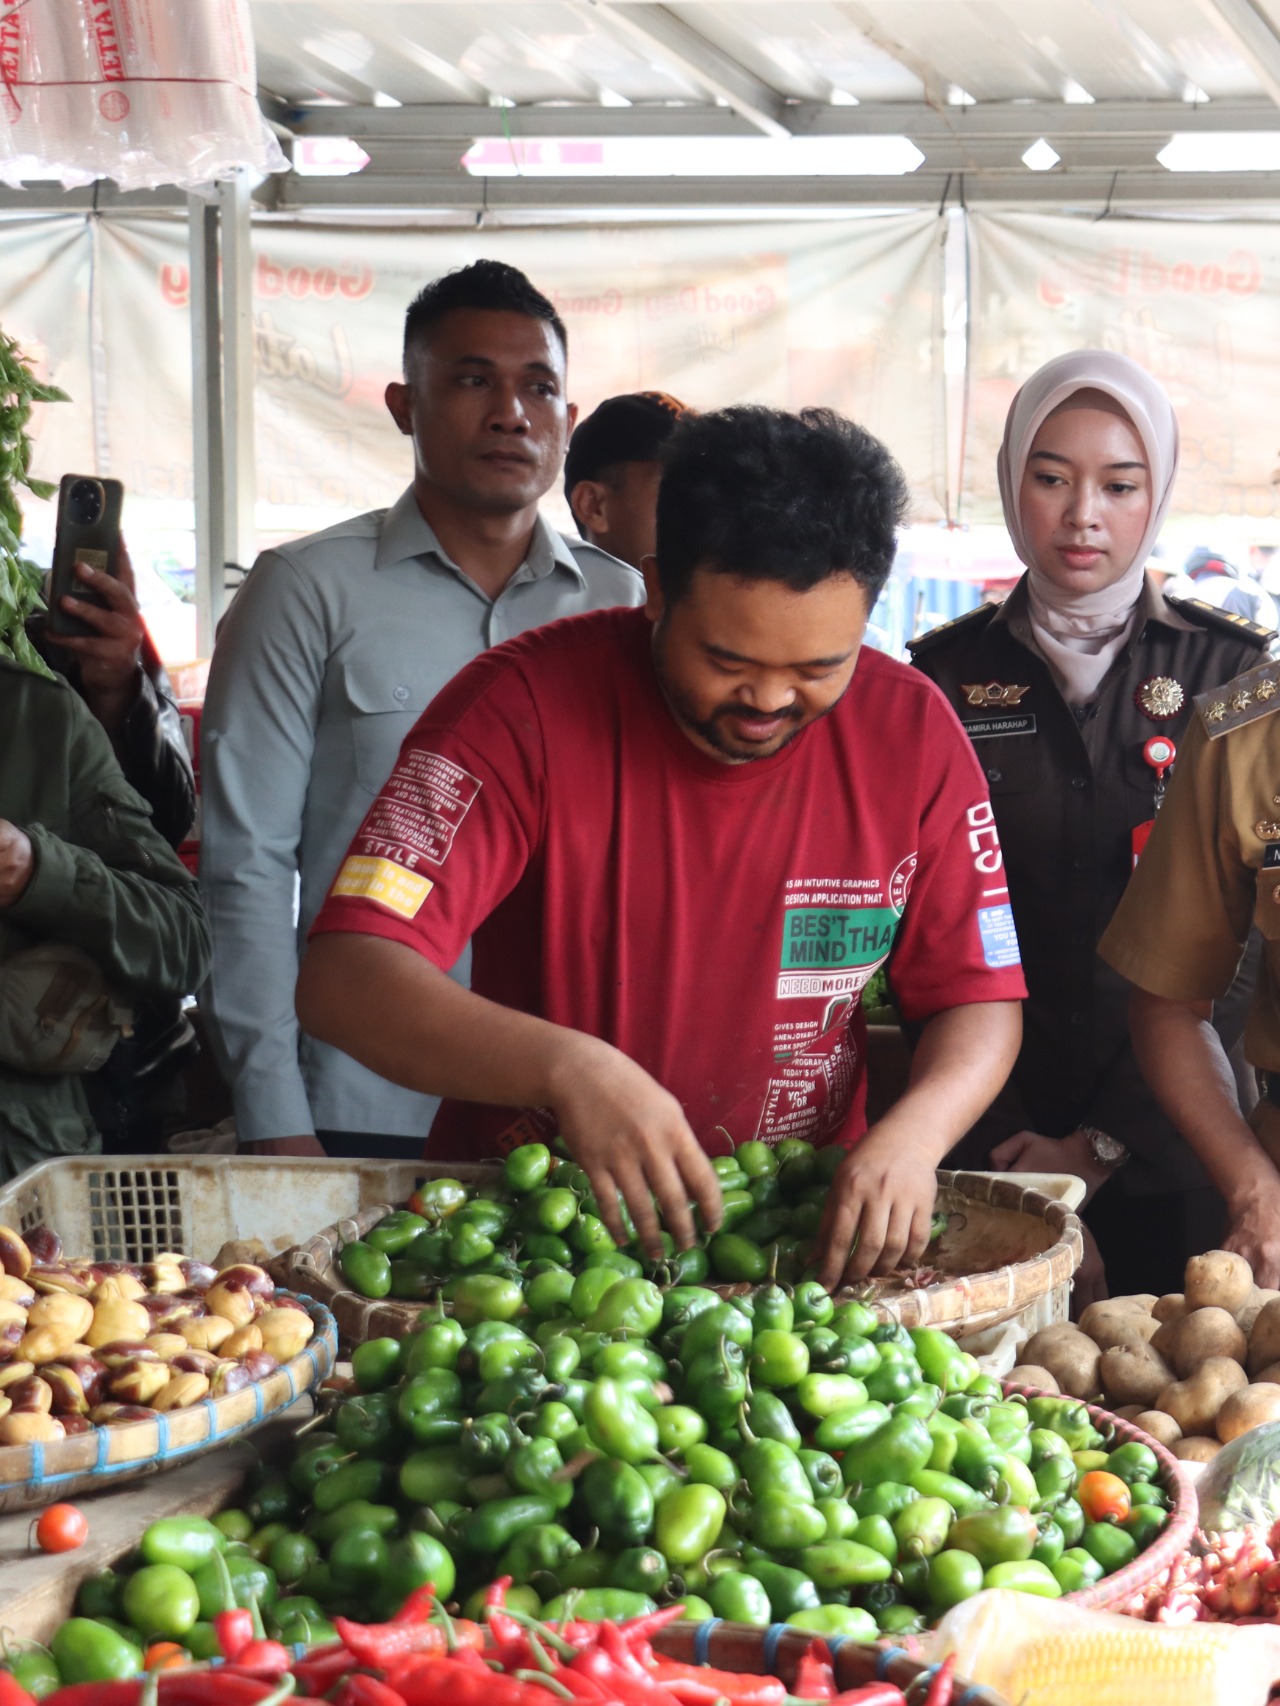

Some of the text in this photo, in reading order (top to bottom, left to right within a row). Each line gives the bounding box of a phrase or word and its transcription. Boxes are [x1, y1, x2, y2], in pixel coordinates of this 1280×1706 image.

[992, 720, 1028, 731] HARAHAP
[417, 763, 456, 785] ENJOYABLE
[426, 757, 464, 781] DESIGNERS
[417, 770, 462, 797] EXPERIENCE
[394, 790, 442, 811] AND CREATIVE
[378, 802, 426, 822] USTRATIONS
[364, 840, 420, 868] STYLE
[786, 878, 880, 888] IS AN INTUITIVE GRAPHICS
[785, 893, 884, 905] DESIGN APPLICATION THAT
[790, 914, 850, 938] BES'T
[790, 940, 847, 963] MIND
[774, 1021, 819, 1031] GIVES DESIGN
[773, 1044, 792, 1052] WORK
[765, 1088, 781, 1124] STYLE
